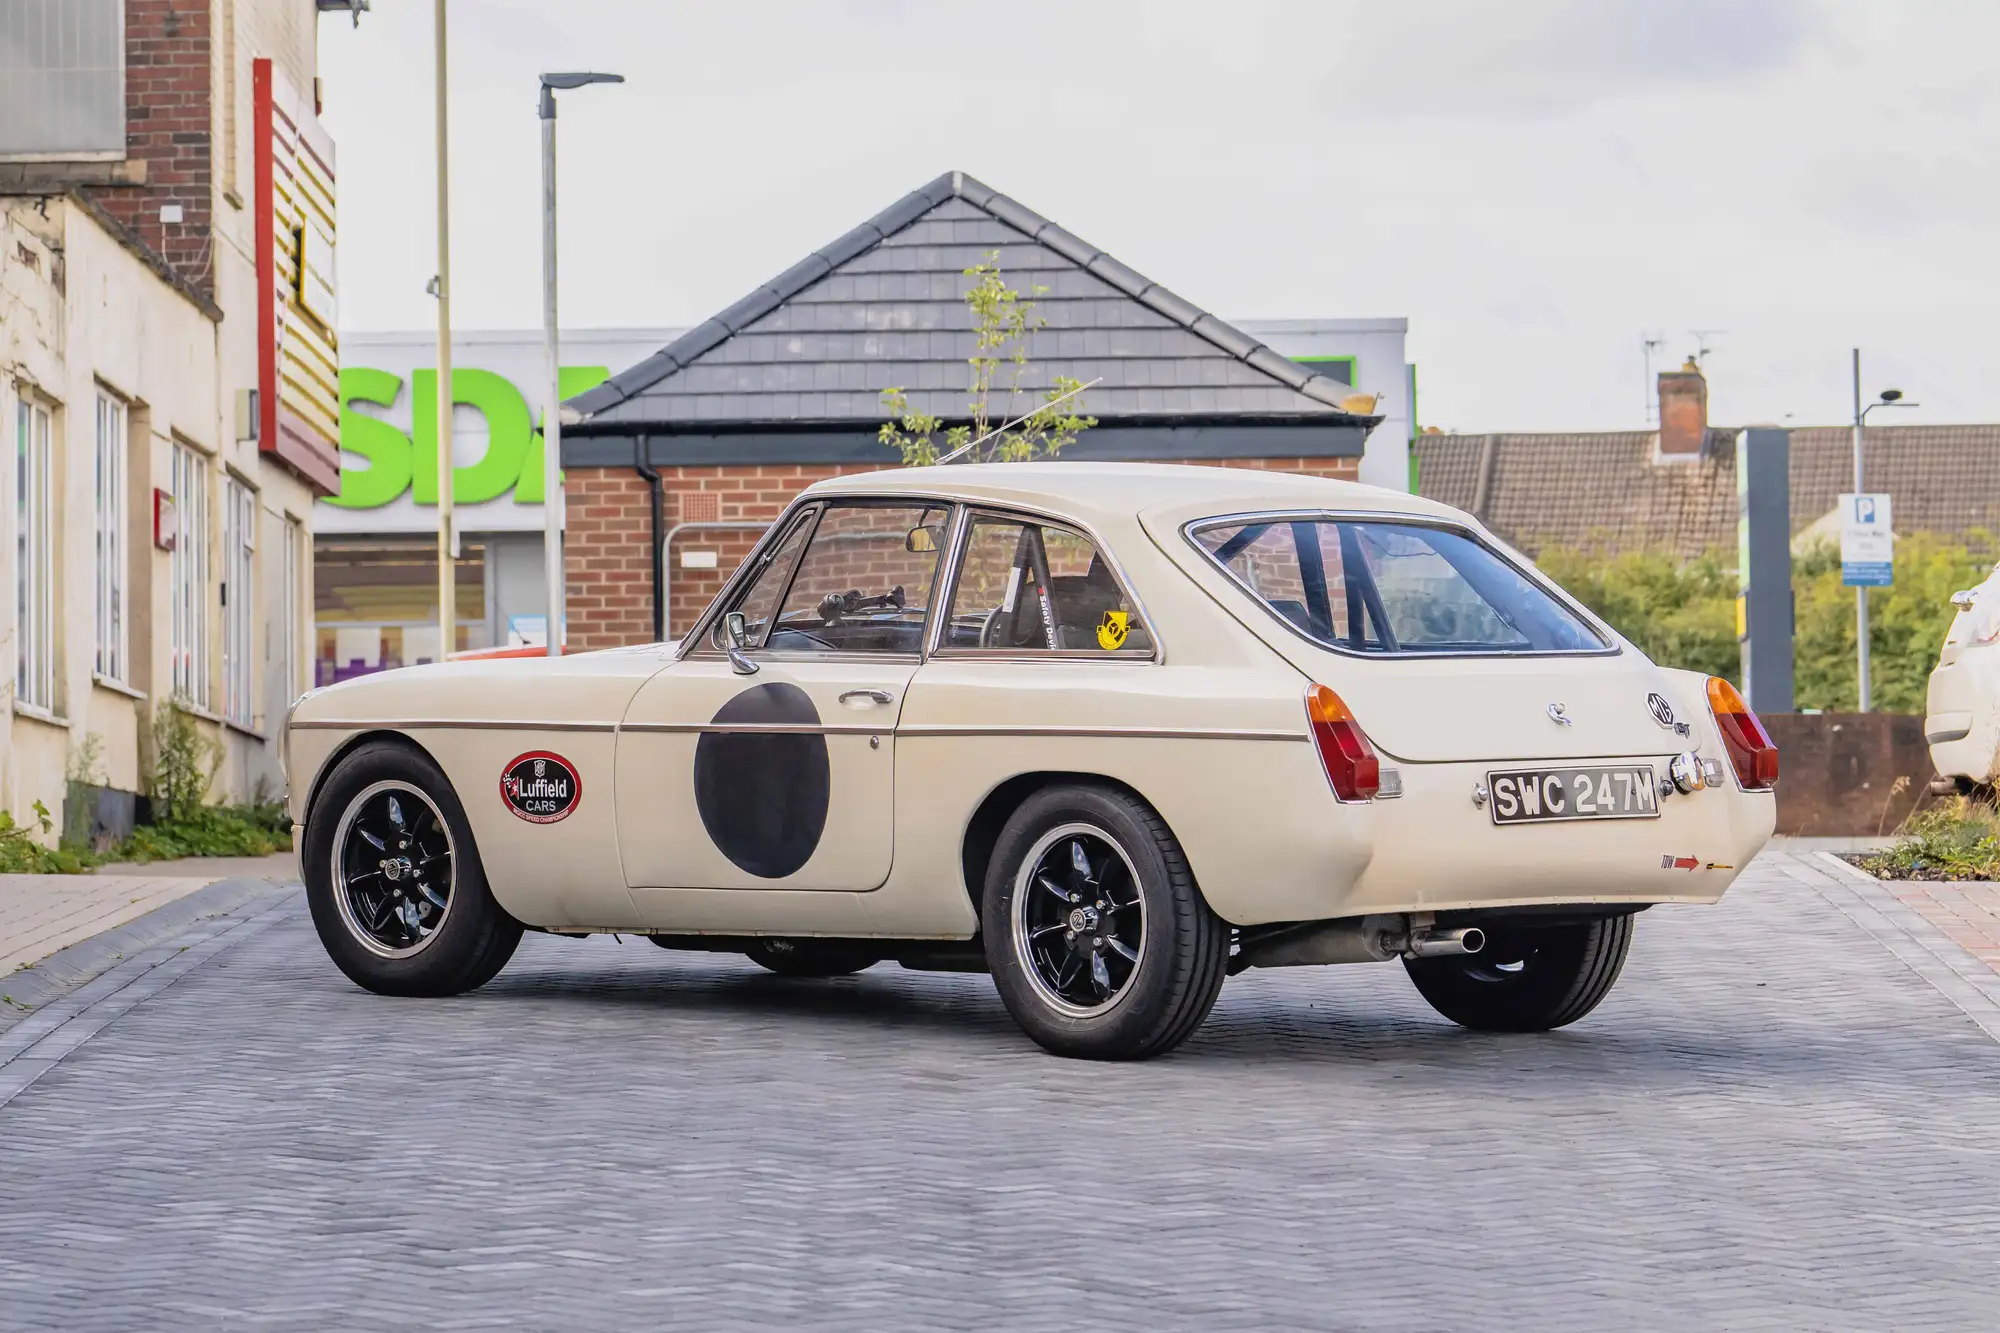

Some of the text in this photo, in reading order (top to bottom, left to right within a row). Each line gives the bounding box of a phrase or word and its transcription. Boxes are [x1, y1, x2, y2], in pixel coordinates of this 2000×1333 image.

[1647, 692, 1674, 725] MG
[519, 778, 567, 798] Luffield
[1494, 772, 1656, 817] SWC 247M
[525, 800, 556, 812] CARS
[1660, 854, 1675, 869] TOW
